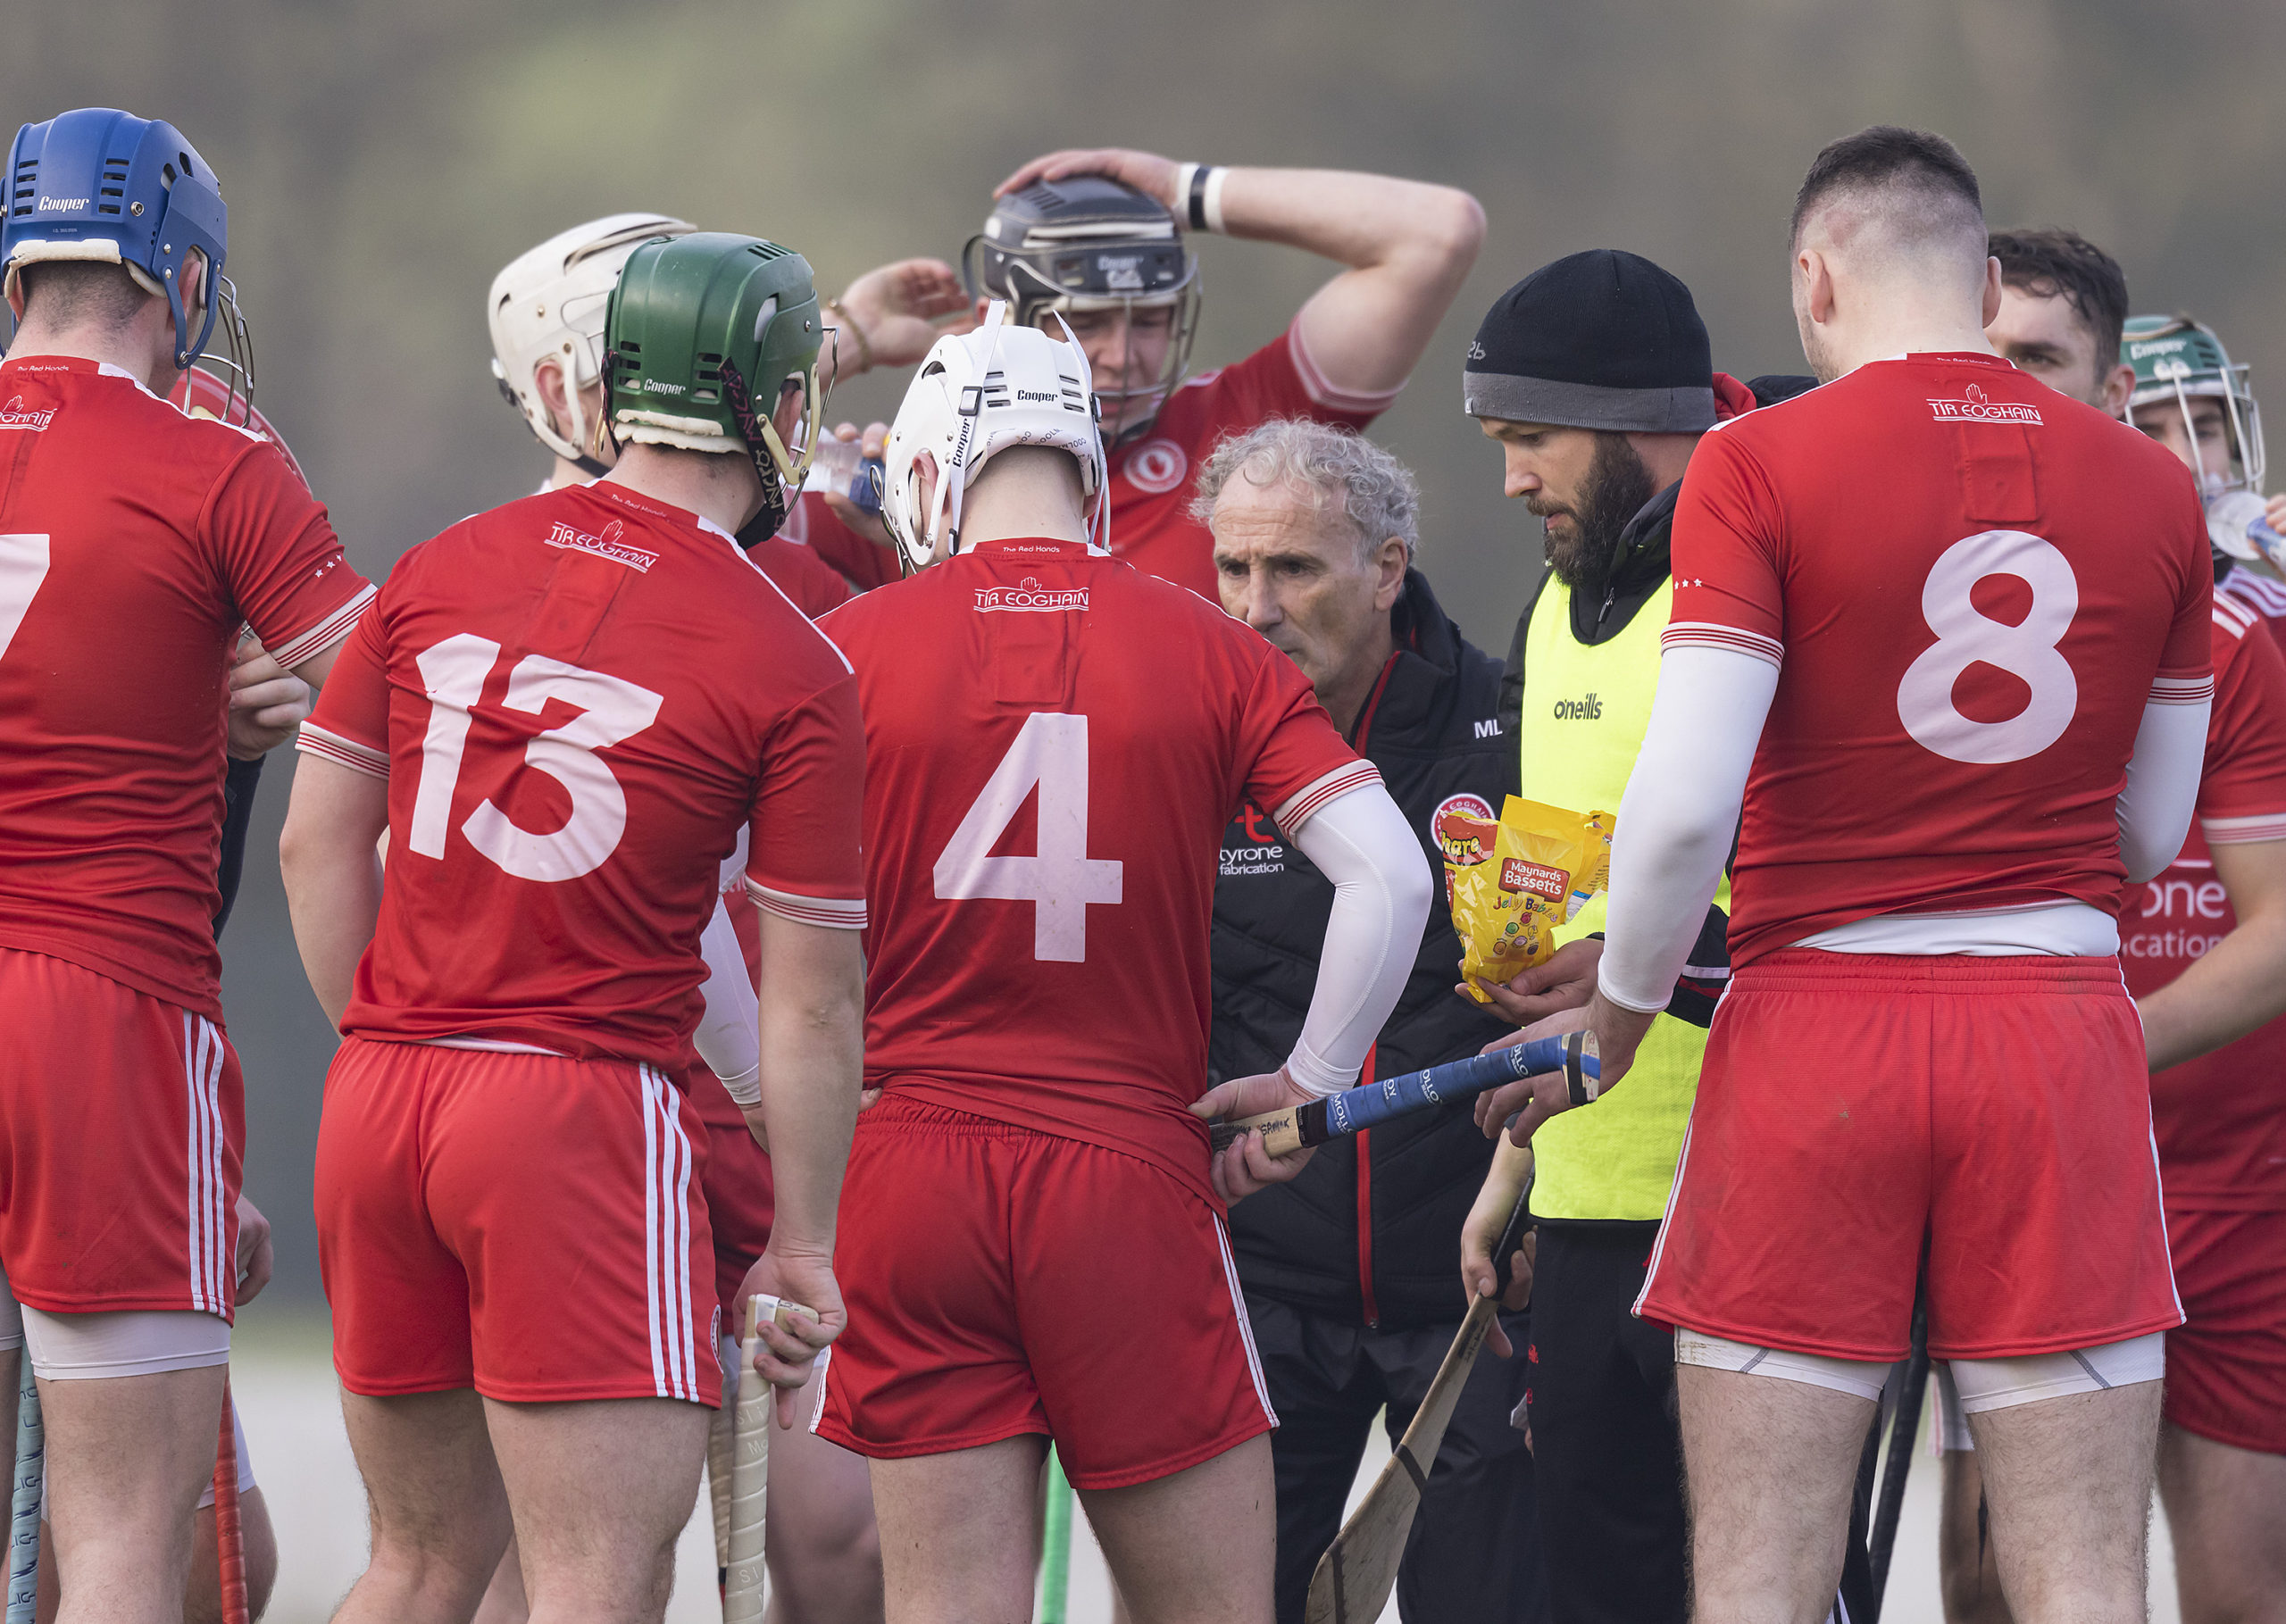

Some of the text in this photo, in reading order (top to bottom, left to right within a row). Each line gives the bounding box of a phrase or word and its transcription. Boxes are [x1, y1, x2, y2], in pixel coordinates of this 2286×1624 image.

[38, 196, 90, 213] Cooper
[644, 379, 686, 396] Cooper
[1017, 389, 1058, 403] Cooper
[1961, 404, 2042, 421] EOGHAIN
[952, 418, 971, 468] Cooper
[576, 534, 656, 568] EOGHAIN
[1005, 592, 1089, 606] EOGHAIN
[1897, 529, 2079, 764] 8
[409, 632, 664, 882] 13
[933, 712, 1123, 963] 4
[1441, 830, 1481, 856] hare
[1220, 845, 1283, 866] tyrone
[1220, 862, 1284, 875] fabrication
[1511, 862, 1562, 882] Maynards
[1505, 870, 1563, 895] Bassetts
[1493, 895, 1558, 922] Jelly Babies
